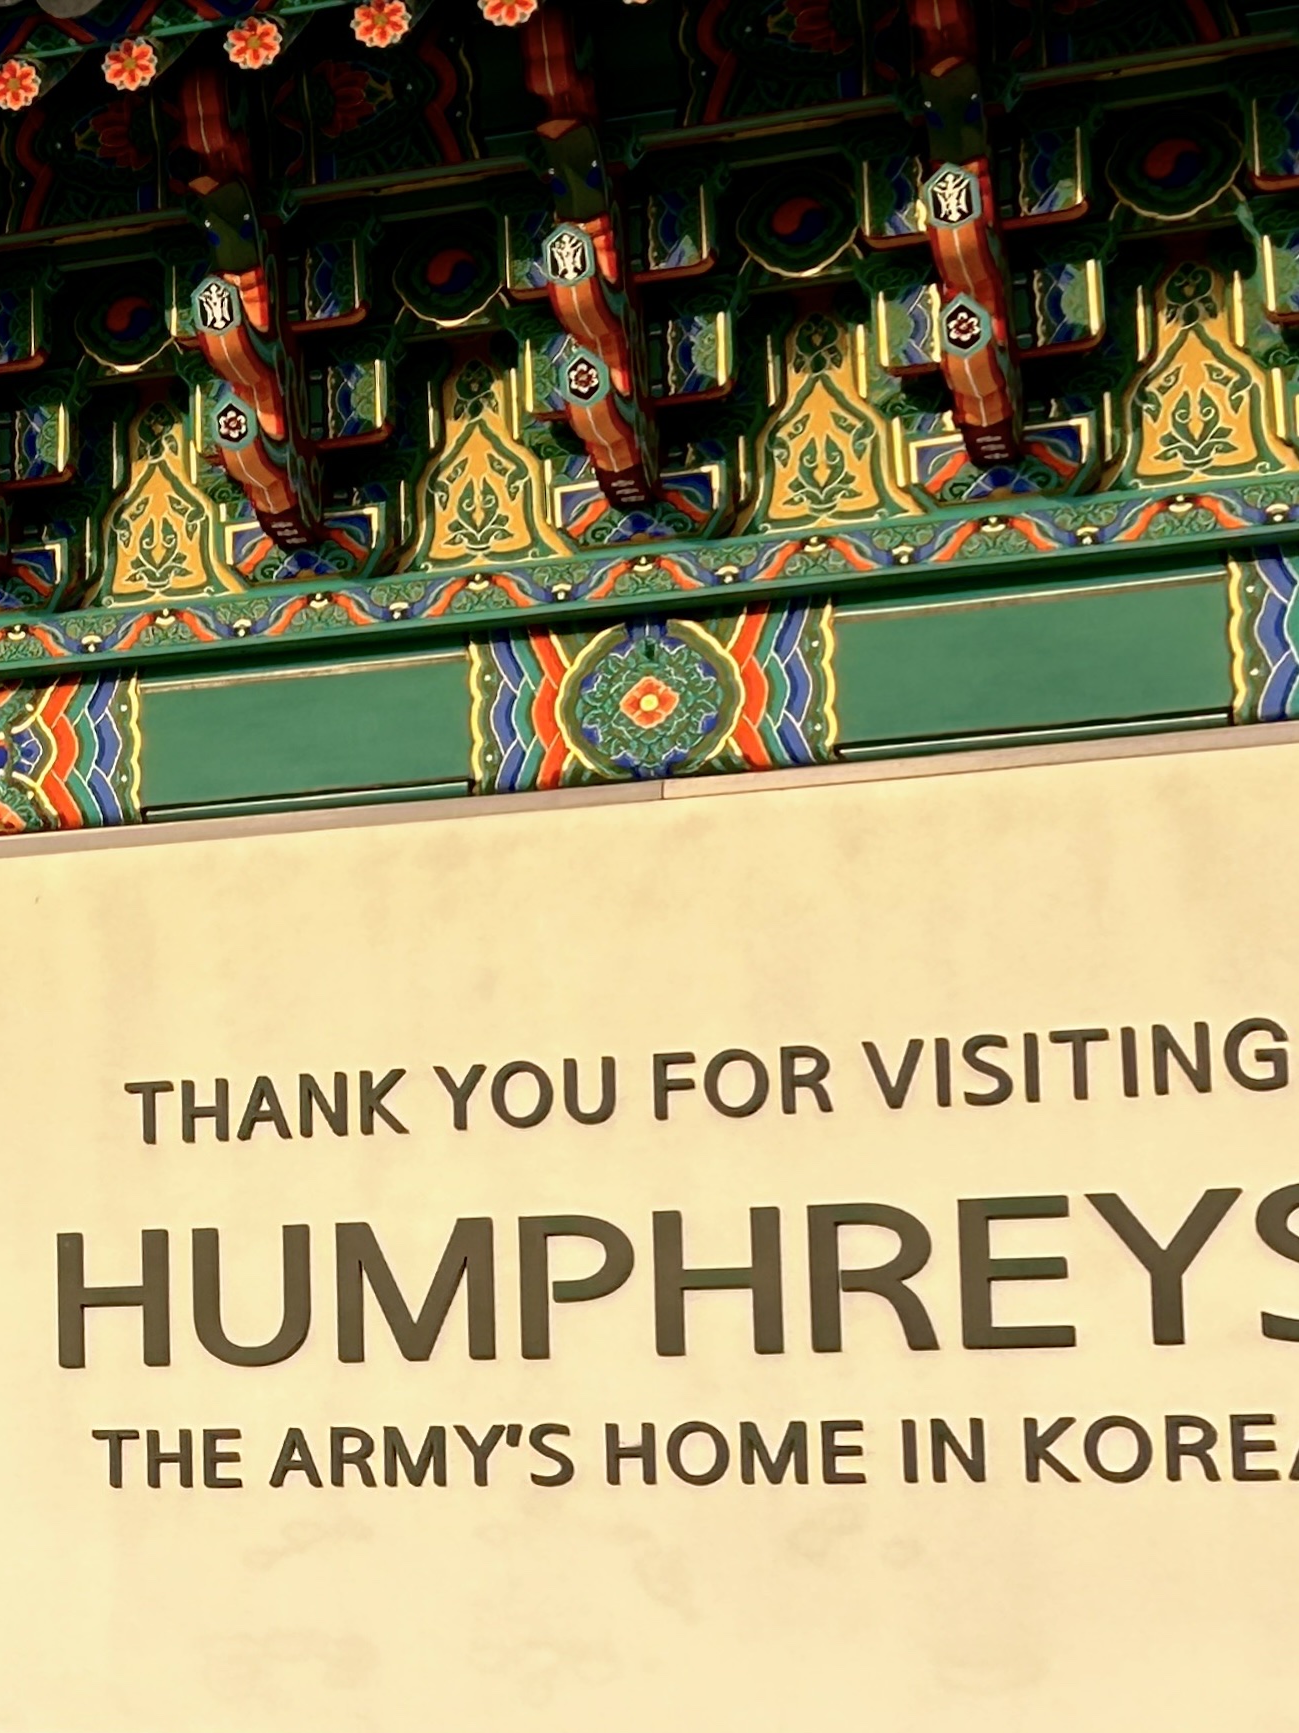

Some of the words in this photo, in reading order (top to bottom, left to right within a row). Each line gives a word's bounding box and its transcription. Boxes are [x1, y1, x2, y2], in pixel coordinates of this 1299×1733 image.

[123, 1068, 410, 1145] THANK
[432, 1056, 617, 1131] YOU
[651, 1045, 835, 1121] FOR
[861, 1017, 1289, 1110] VISITING
[91, 1428, 244, 1489] THE
[268, 1423, 576, 1489] ARMY'S
[605, 1419, 867, 1487] HOME
[901, 1417, 987, 1485] IN
[1023, 1413, 1299, 1484] KORE
